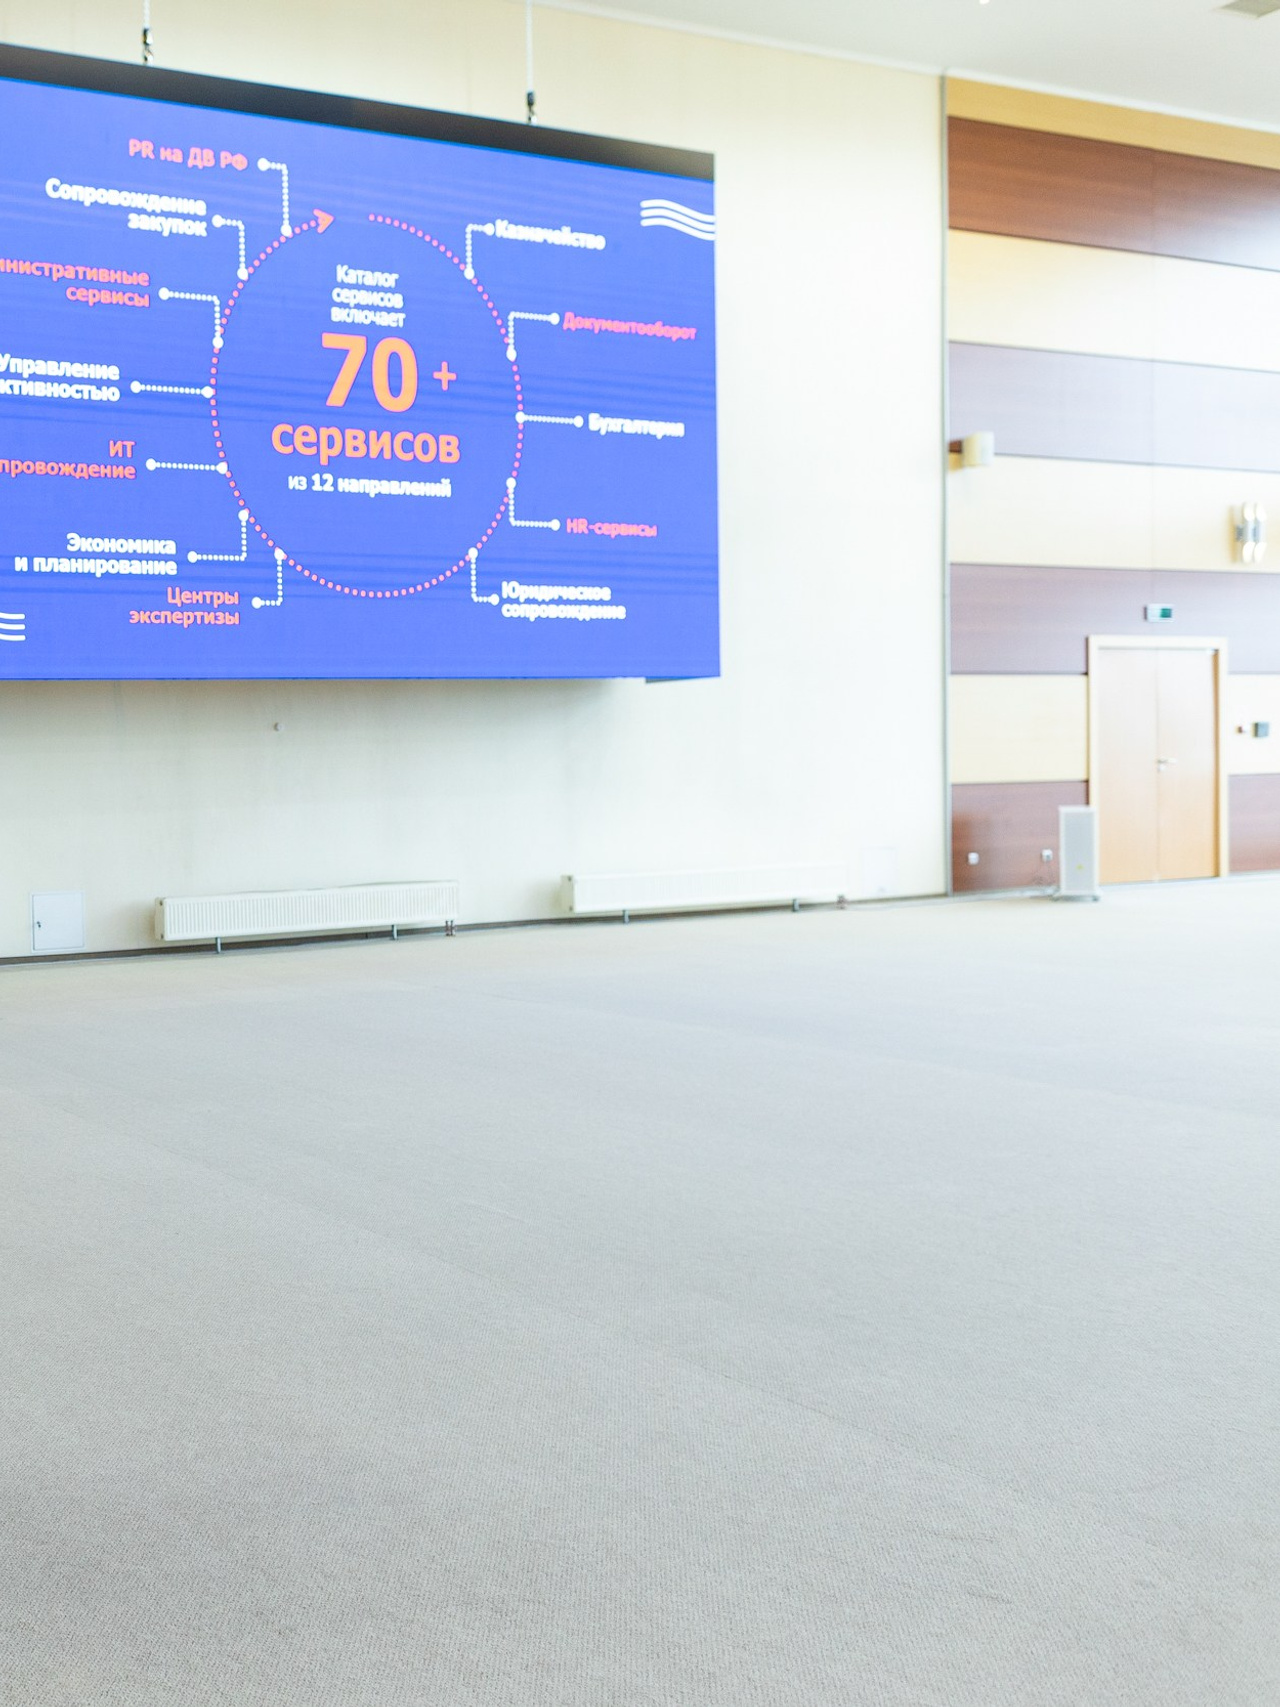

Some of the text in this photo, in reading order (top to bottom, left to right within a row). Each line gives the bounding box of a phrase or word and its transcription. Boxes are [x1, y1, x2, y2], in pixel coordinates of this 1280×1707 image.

[128, 138, 249, 171] PR на ДВ РФ
[45, 177, 208, 216] Сопровождение
[127, 211, 208, 237] закупок
[335, 264, 400, 288] Каталог
[65, 286, 150, 308] сервисы
[331, 287, 404, 309] сервисов
[330, 306, 406, 328] включает
[563, 311, 697, 342] Документооборот
[321, 332, 418, 412] 70
[109, 440, 136, 458] ИТ
[271, 423, 461, 466] сервисов
[288, 473, 452, 498] из 12 направлений
[566, 517, 658, 539] HR-сервисы
[66, 532, 177, 555] Экономика
[14, 556, 178, 578] и планирование
[167, 586, 239, 609] Центры
[129, 608, 240, 629] экспертизы
